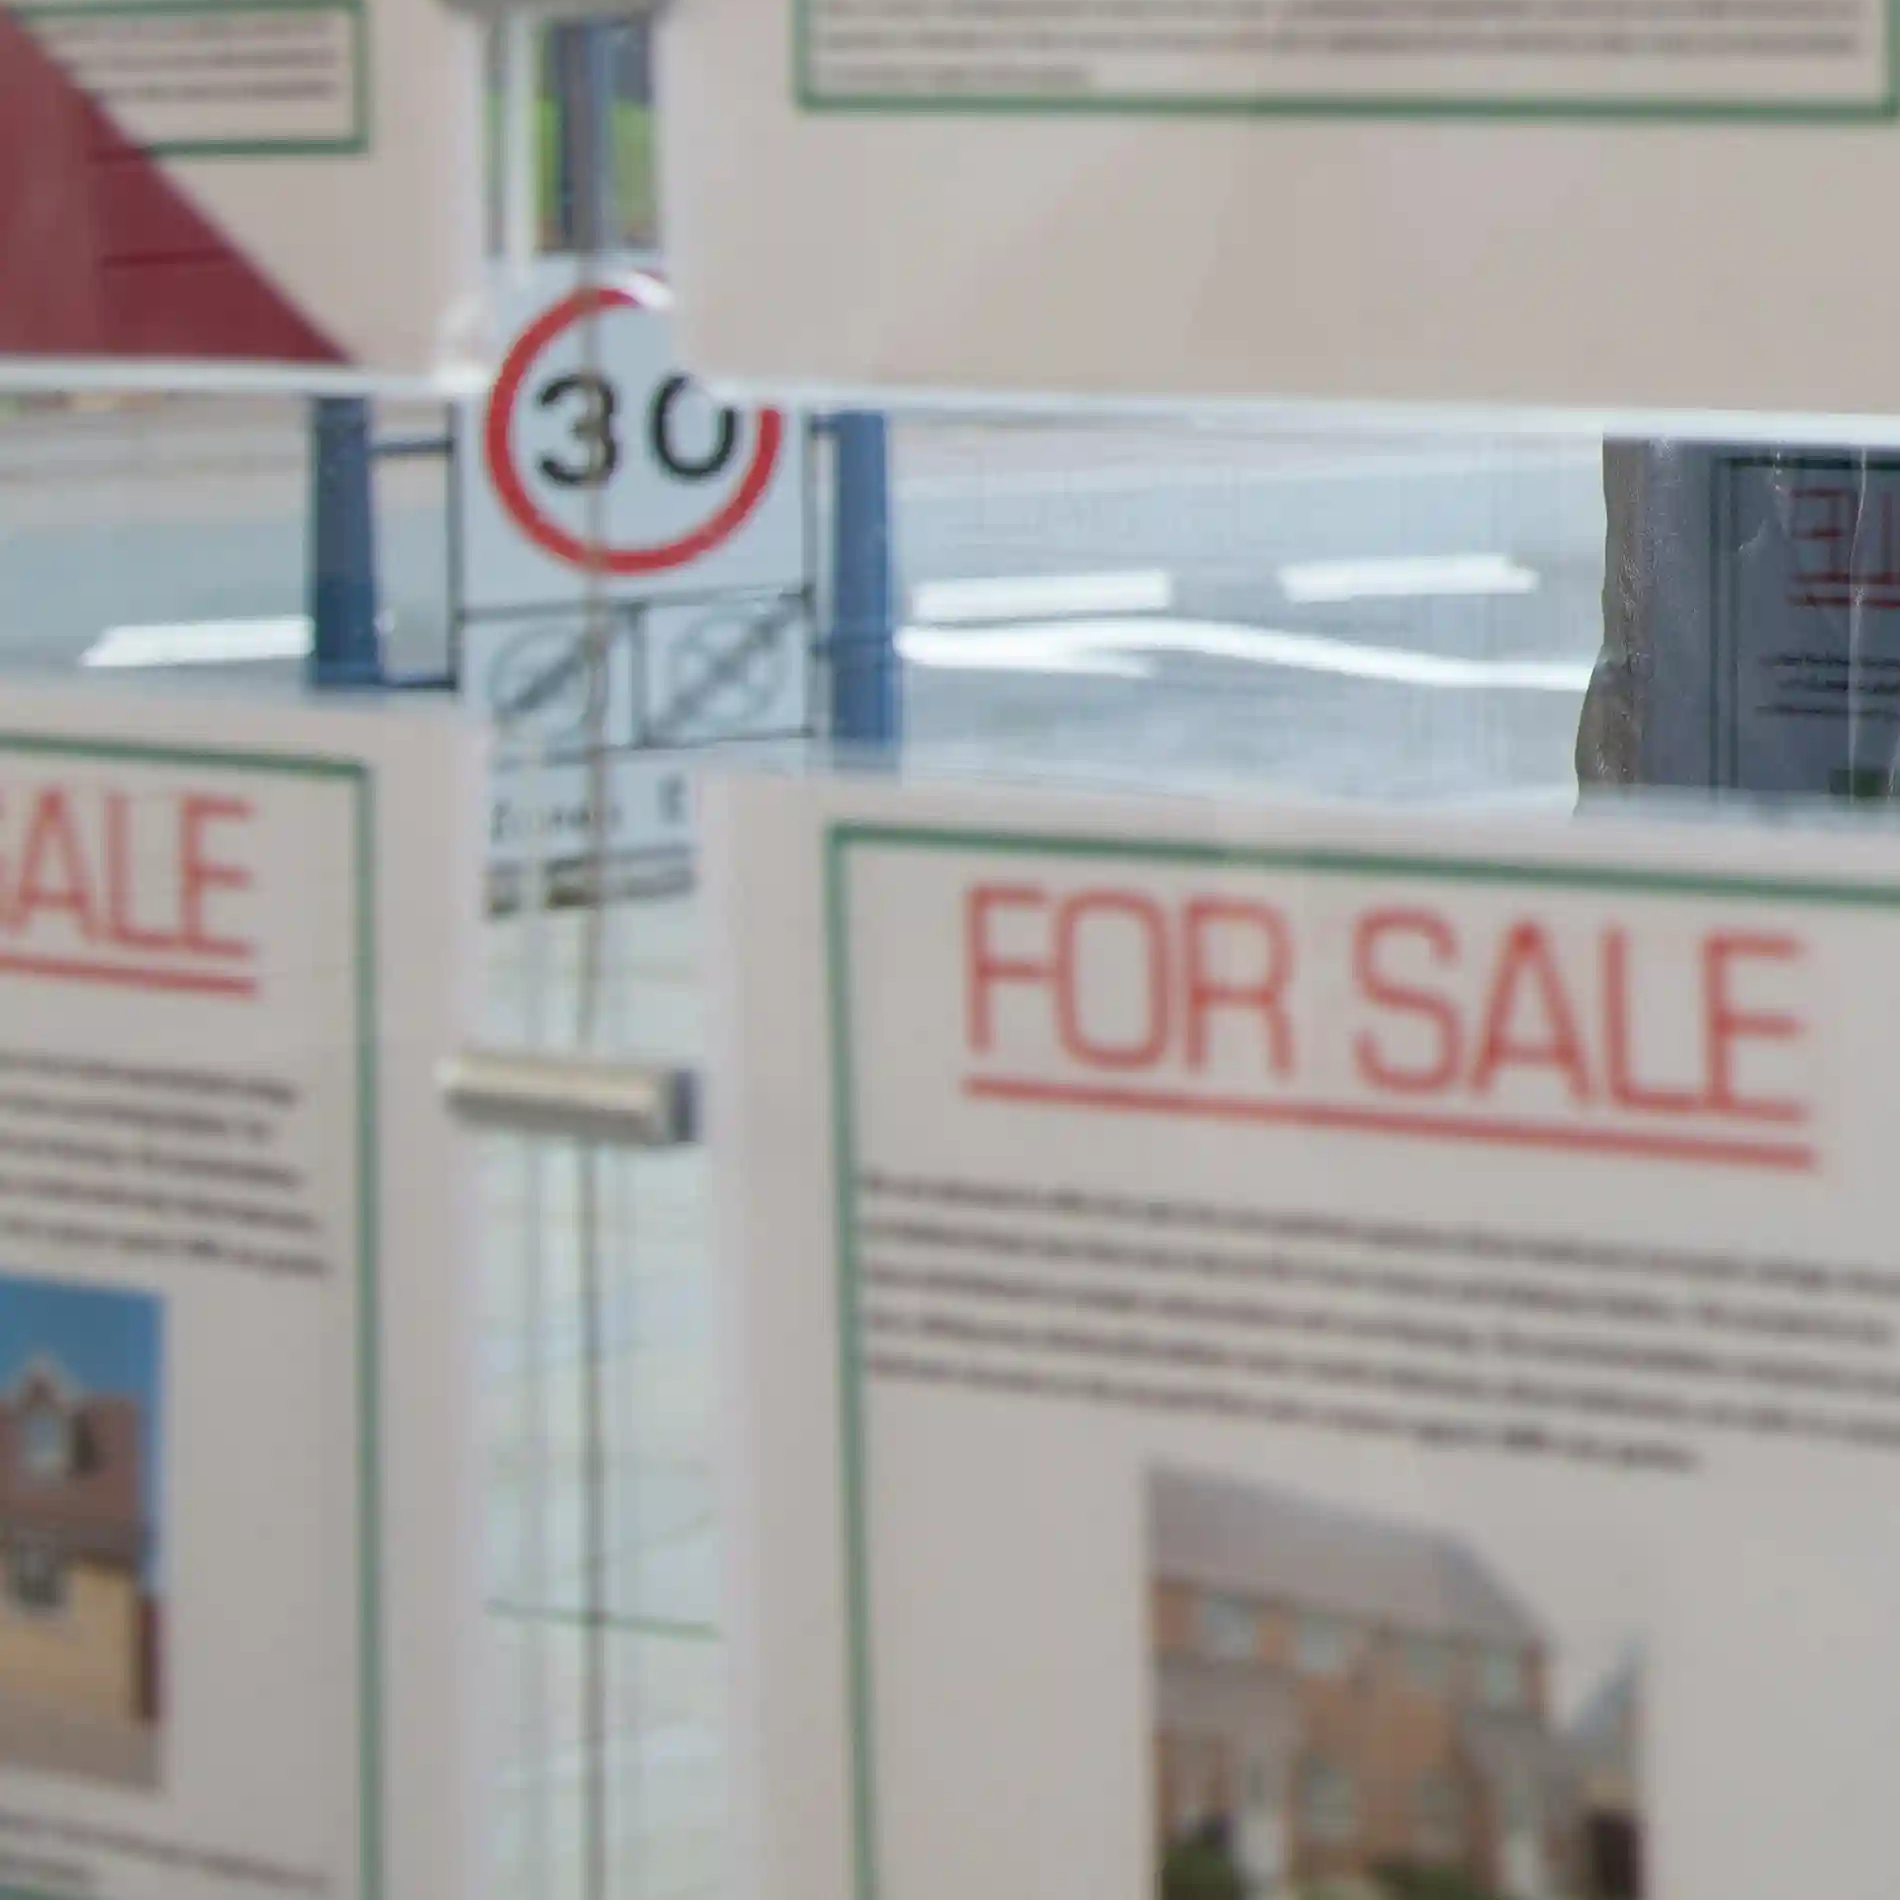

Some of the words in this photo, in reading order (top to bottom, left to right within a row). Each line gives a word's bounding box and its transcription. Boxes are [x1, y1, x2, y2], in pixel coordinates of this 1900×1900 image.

[538, 372, 737, 482] 30
[0, 785, 258, 956] ALE
[963, 883, 1297, 1082] FOR
[1350, 904, 1812, 1124] SALE
